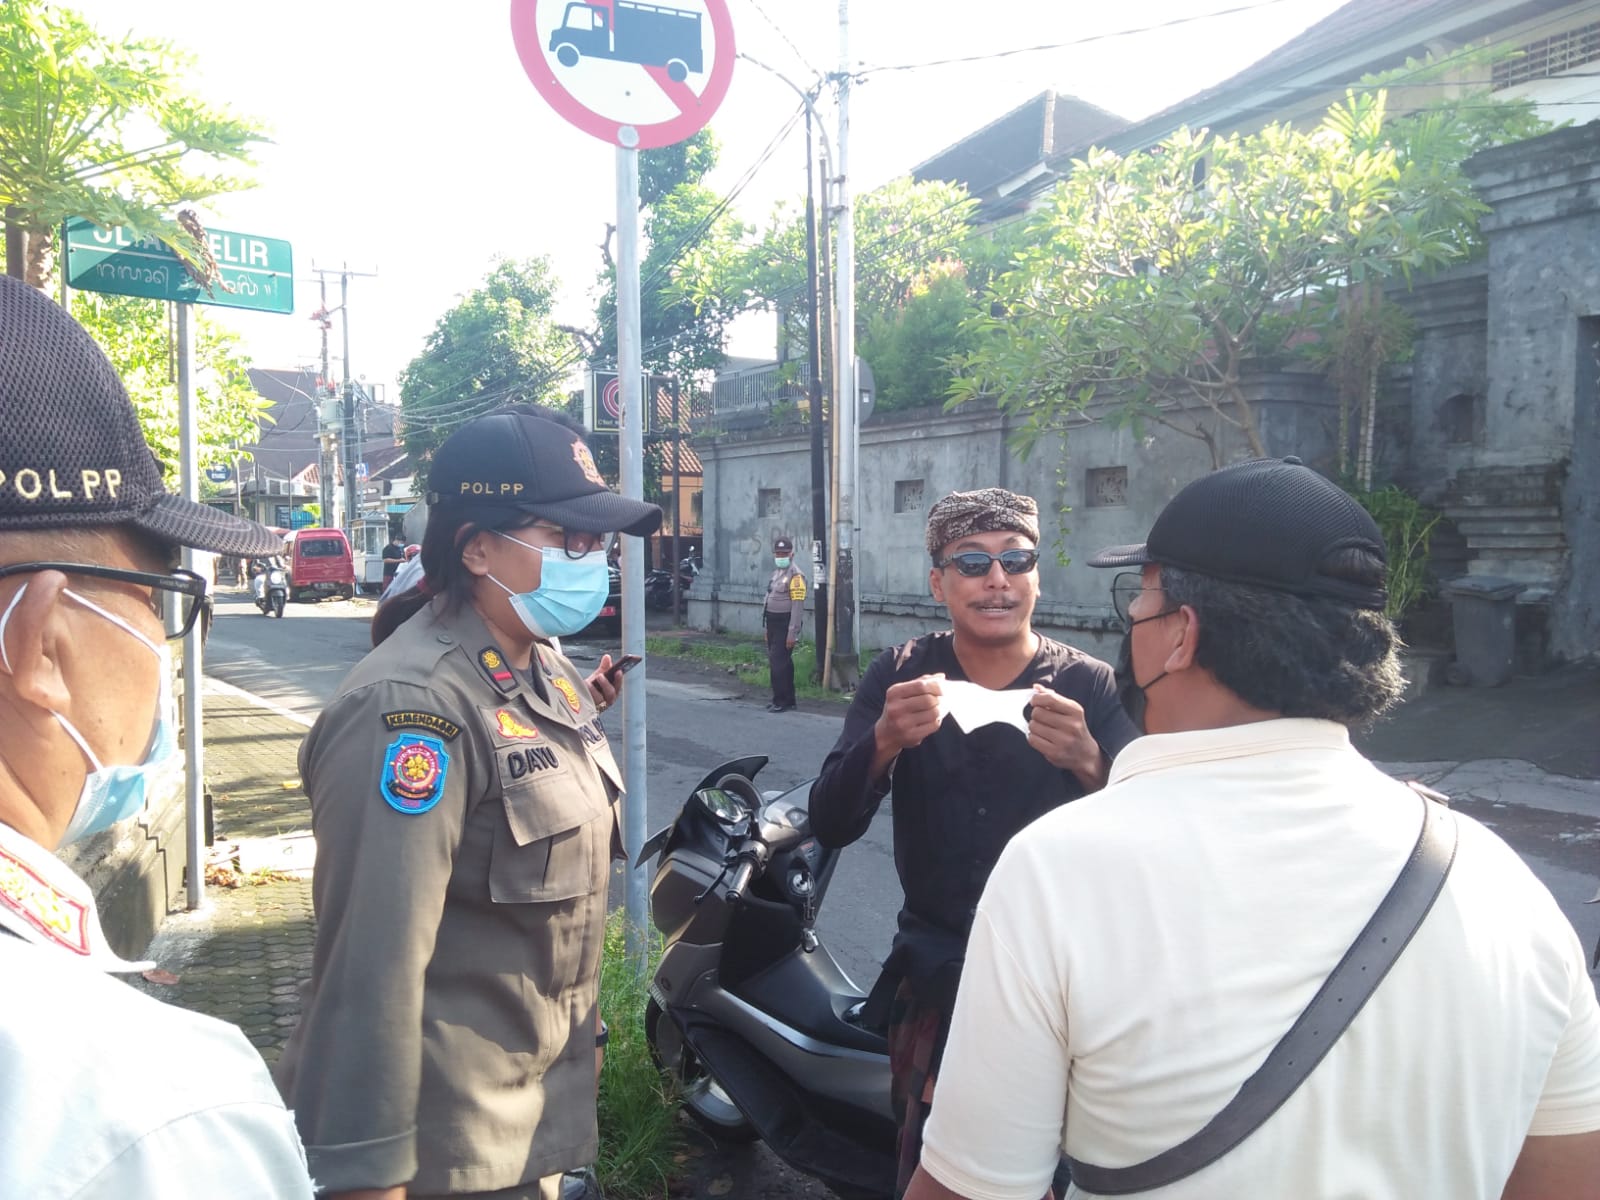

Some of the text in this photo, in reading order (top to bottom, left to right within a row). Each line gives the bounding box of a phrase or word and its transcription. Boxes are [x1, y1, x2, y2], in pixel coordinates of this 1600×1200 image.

[81, 468, 122, 499] PP
[460, 482, 524, 496] POL PP
[508, 746, 559, 779] DAYU
